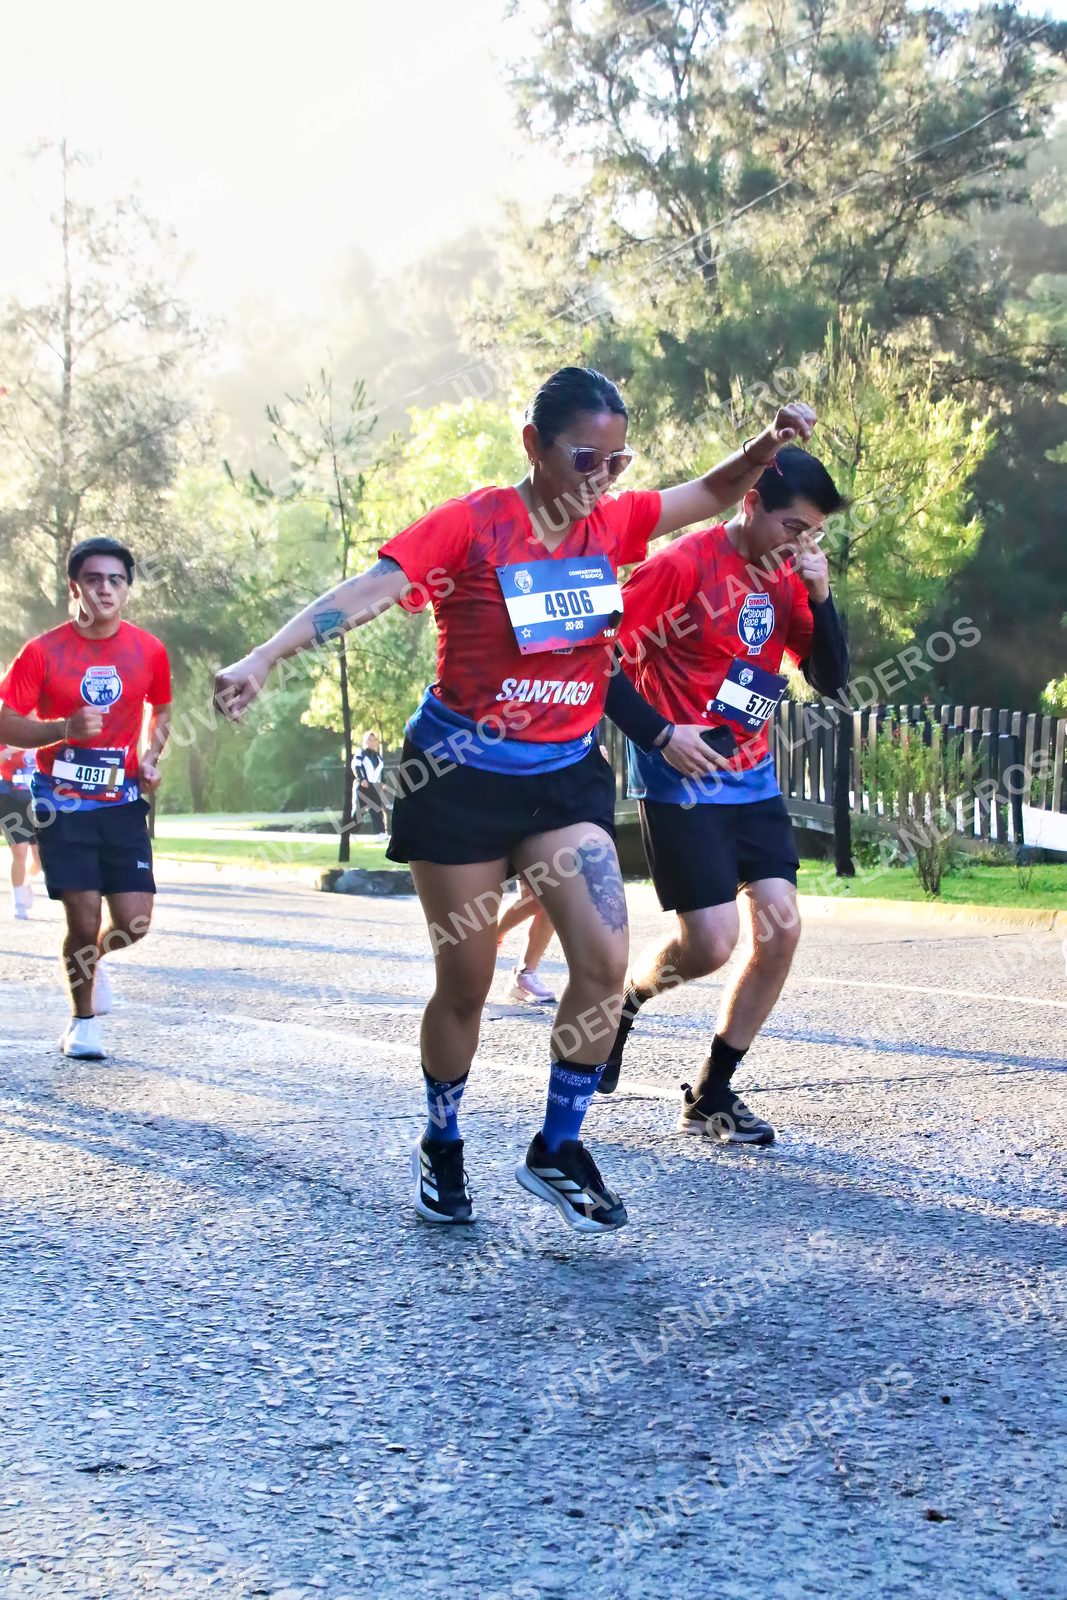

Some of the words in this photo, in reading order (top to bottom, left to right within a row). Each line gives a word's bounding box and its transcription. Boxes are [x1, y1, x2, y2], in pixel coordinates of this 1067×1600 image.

[544, 590, 594, 618] 4906
[743, 618, 758, 627] Race
[496, 678, 594, 706] SANTIAGO
[75, 766, 106, 783] 4031
